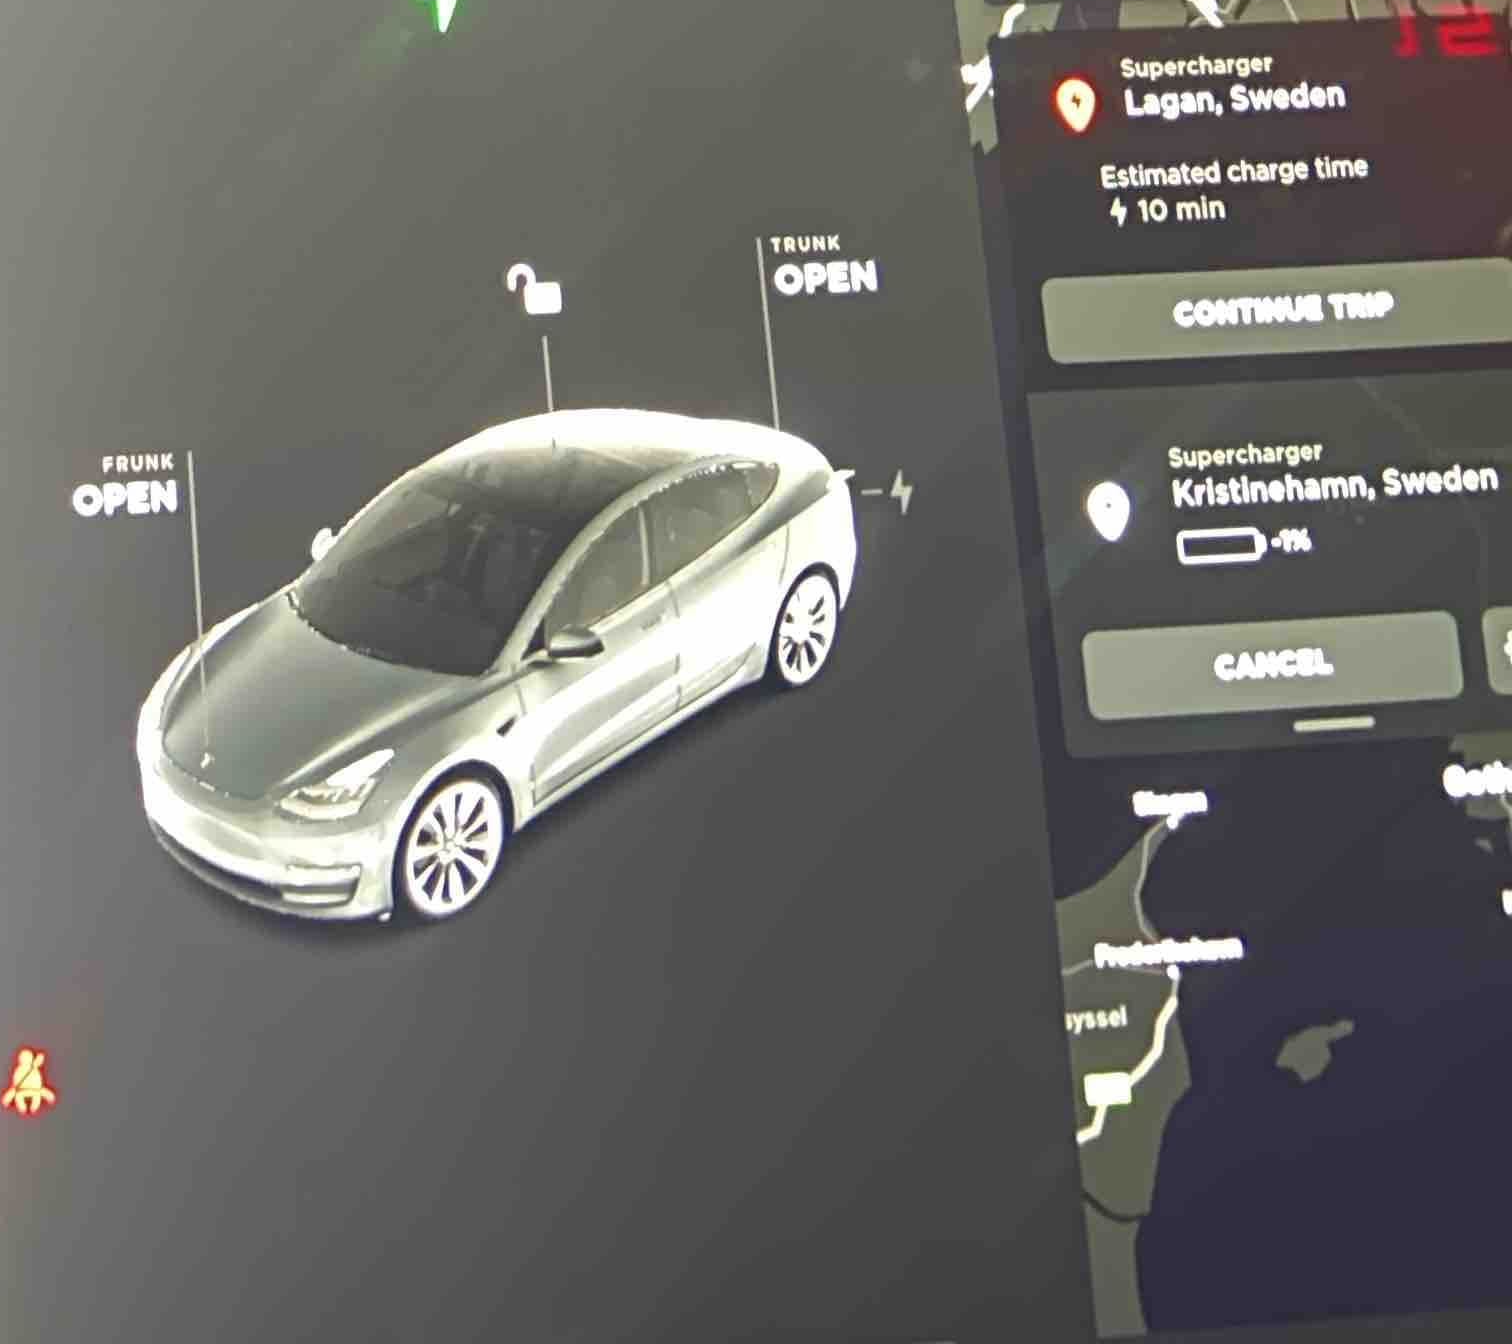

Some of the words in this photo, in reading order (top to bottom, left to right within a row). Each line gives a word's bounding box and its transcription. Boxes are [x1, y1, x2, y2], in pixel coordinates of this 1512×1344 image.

[1120, 55, 1273, 82] Supercharger
[1124, 88, 1224, 121] Lagan,
[1229, 81, 1346, 112] Sweden
[1100, 159, 1222, 190] Estimated
[1226, 159, 1310, 186] charge
[1313, 155, 1369, 180] time
[1137, 198, 1169, 223] 10
[1175, 195, 1226, 221] min
[770, 234, 841, 254] TRUNK
[773, 260, 878, 296] OPEN
[1173, 294, 1325, 328] CONTINUE
[101, 452, 175, 474] FRUNK
[1167, 442, 1324, 471] Supercharger
[72, 479, 178, 517] OPEN
[1171, 473, 1377, 508] Kristinehamn,
[1382, 463, 1499, 497] Sweden
[1213, 647, 1335, 681] CANCEL
